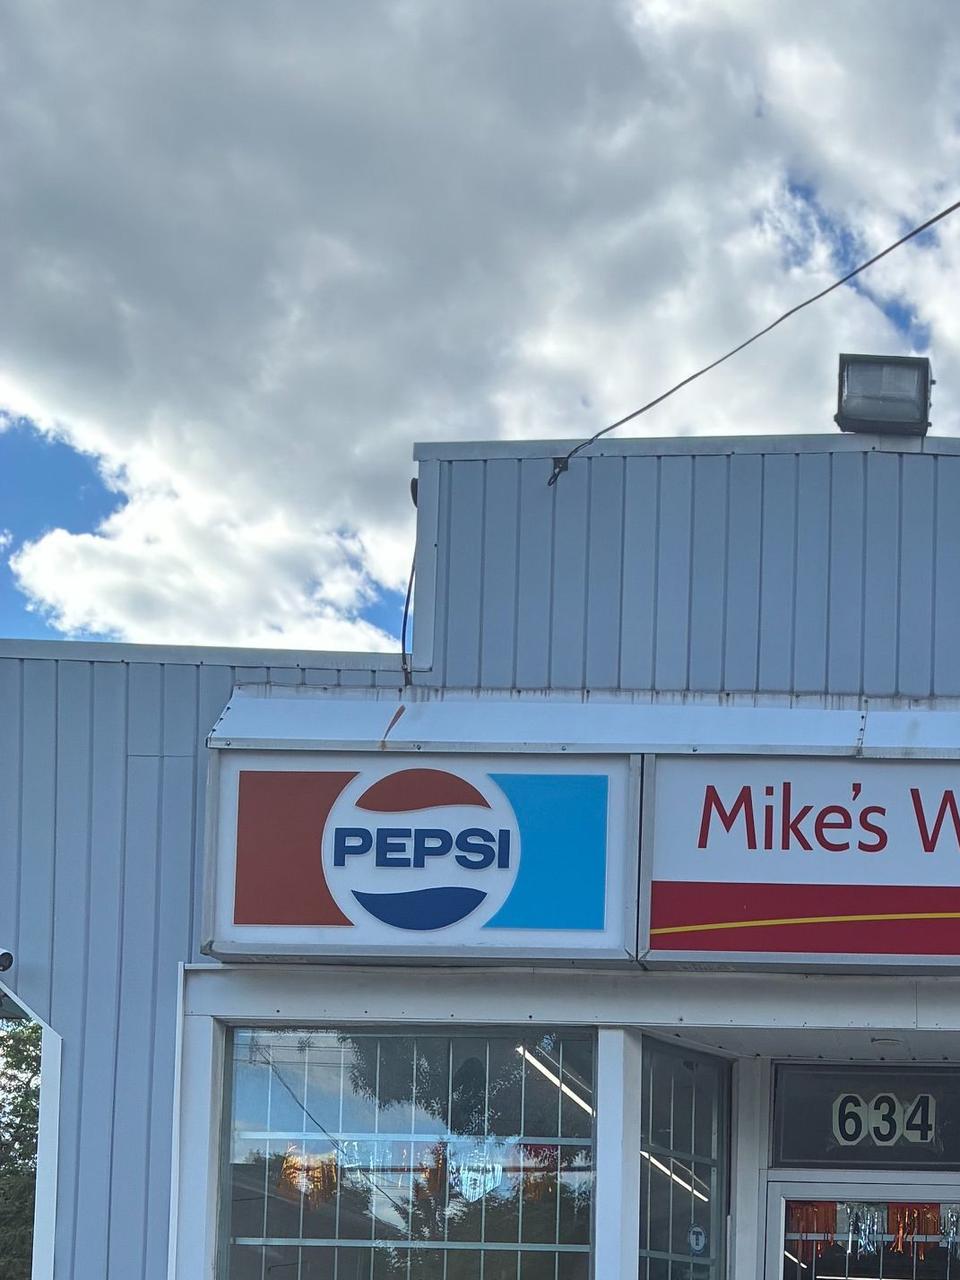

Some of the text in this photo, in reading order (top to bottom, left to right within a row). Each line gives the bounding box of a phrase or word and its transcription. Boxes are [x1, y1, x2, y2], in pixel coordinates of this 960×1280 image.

[698, 781, 888, 852] Mike's
[333, 827, 511, 870] PEPSI
[838, 1094, 933, 1142] 634
